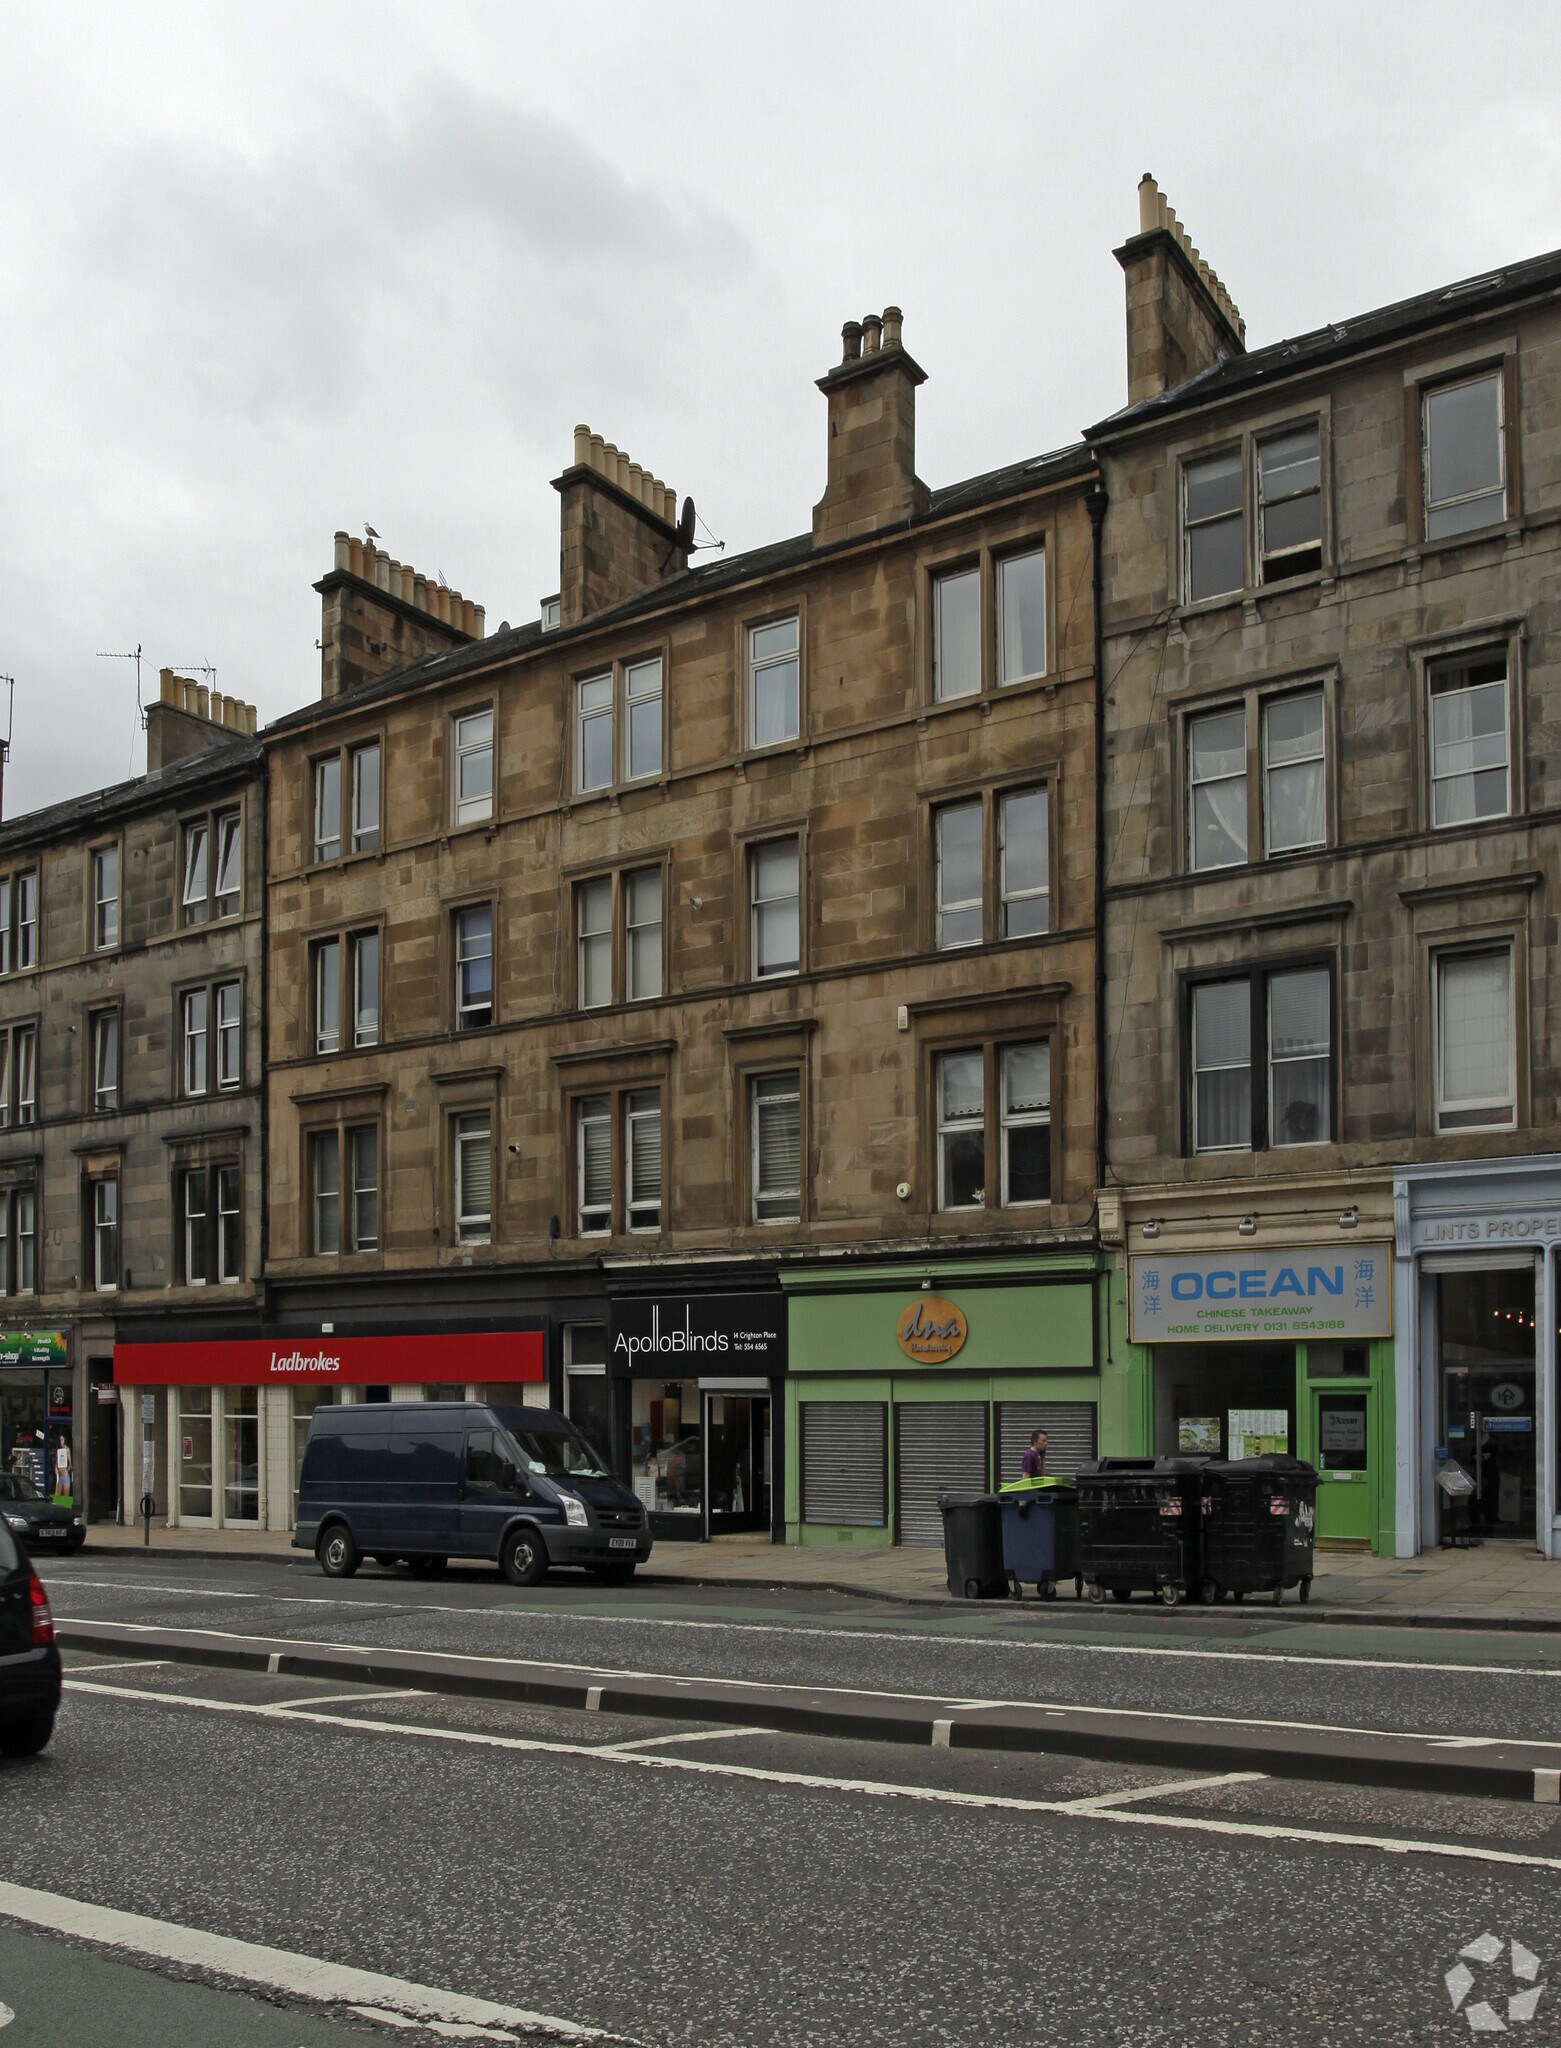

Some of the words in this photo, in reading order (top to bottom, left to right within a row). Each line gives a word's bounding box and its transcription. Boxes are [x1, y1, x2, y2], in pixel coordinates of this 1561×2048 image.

[1424, 1223, 1480, 1241] LINTS
[1486, 1216, 1561, 1238] PROPE
[1171, 1266, 1344, 1300] OCEAN
[903, 1304, 960, 1340] dna
[1197, 1309, 1246, 1319] CHINESE
[1252, 1307, 1313, 1317] TAKEAWAY
[740, 1331, 762, 1340] Crighton
[763, 1331, 777, 1339] Place
[1167, 1325, 1199, 1334] HOME
[1204, 1323, 1259, 1333] DELIVERY
[1264, 1321, 1287, 1331] 0131
[1292, 1320, 1345, 1330] 5543188
[270, 1351, 340, 1371] Ladbrokes
